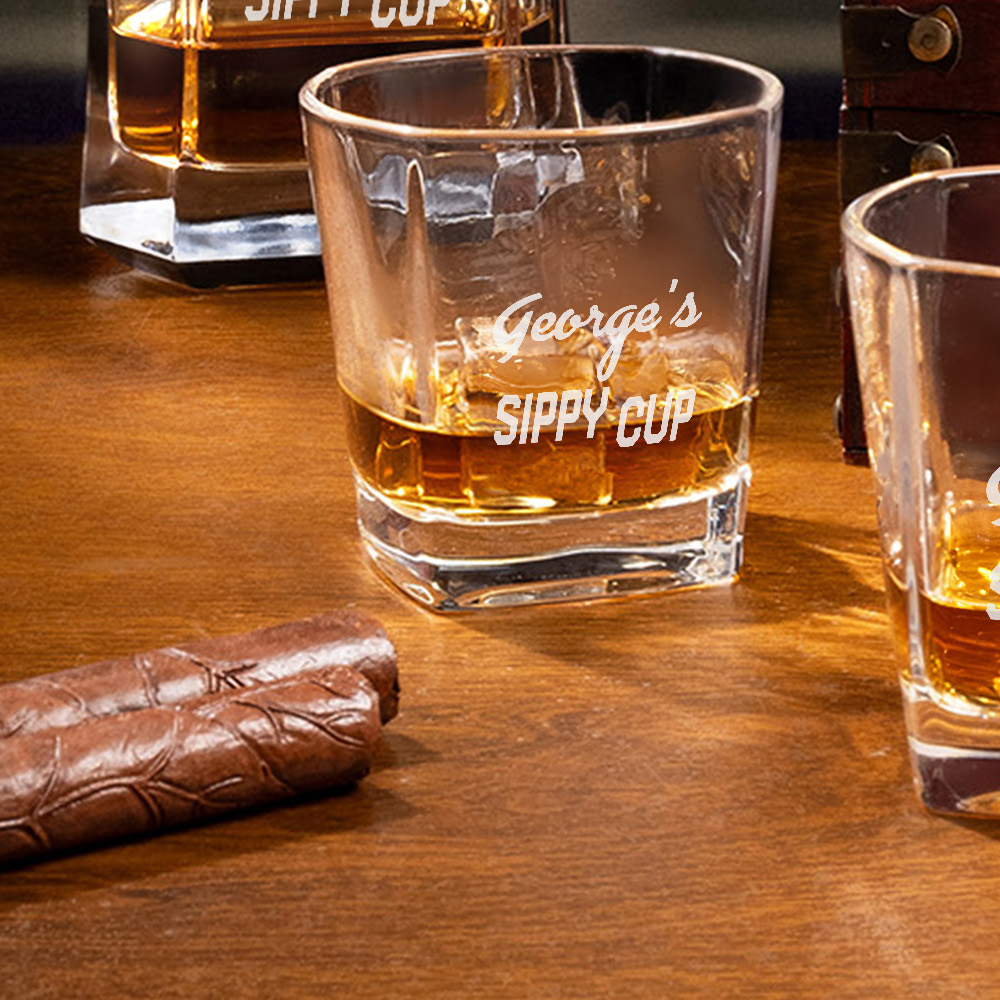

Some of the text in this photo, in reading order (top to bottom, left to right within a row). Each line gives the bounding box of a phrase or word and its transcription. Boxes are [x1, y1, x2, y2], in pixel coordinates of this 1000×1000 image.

[491, 279, 702, 380] George's
[494, 387, 696, 447] SIPPY CUP
